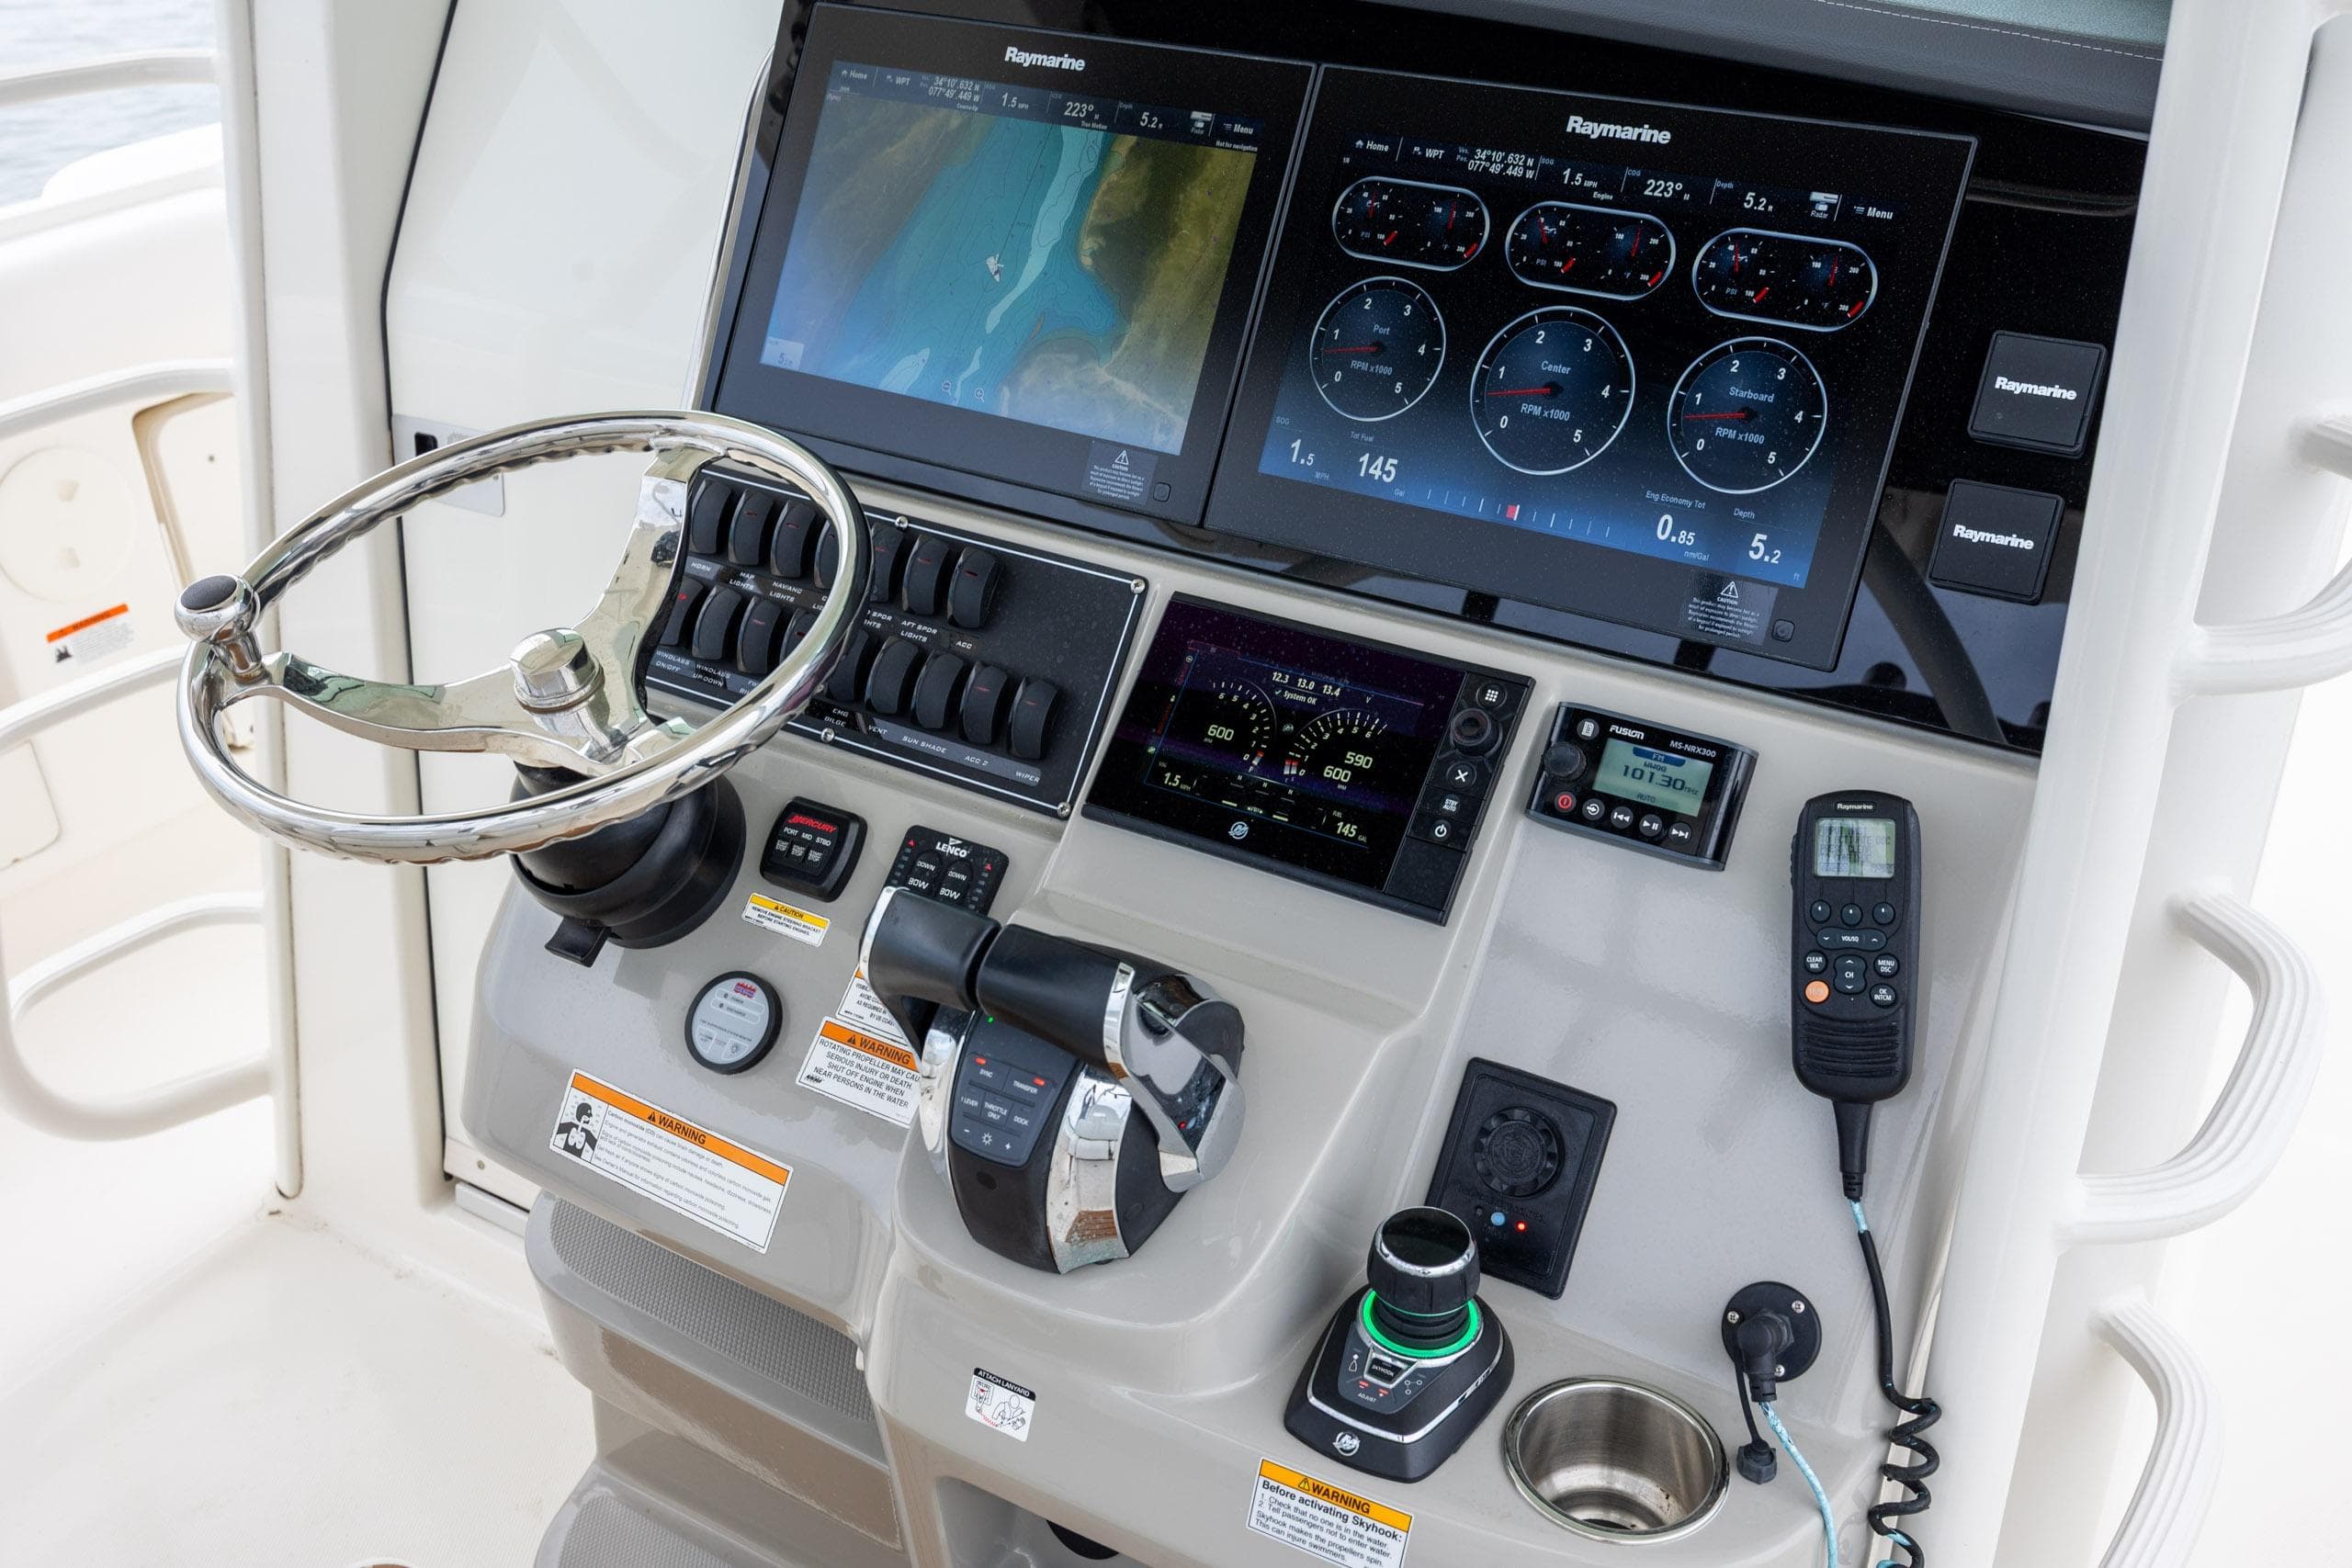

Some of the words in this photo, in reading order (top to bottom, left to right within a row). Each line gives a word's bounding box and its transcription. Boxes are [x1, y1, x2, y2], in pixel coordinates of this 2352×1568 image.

[1005, 46, 1085, 71] Raymarine
[850, 70, 867, 80] Home
[896, 75, 910, 86] WPT
[1001, 92, 1016, 108] 1.5
[1064, 102, 1094, 118] 223°
[1139, 112, 1159, 129] 5.2
[1233, 123, 1254, 135] Menu
[1566, 115, 1671, 144] Raymarine
[1366, 141, 1389, 152] Home
[1425, 148, 1444, 159] WPT
[1527, 157, 1533, 167] N
[1526, 170, 1534, 179] W
[1563, 167, 1583, 186] 1.5
[1584, 180, 1598, 188] MPH
[1627, 169, 1641, 177] COG
[1644, 179, 1683, 197] 223°
[1593, 191, 1613, 201] Engine
[1744, 192, 1767, 211] 5.2
[1810, 209, 1828, 220] Radar
[1867, 207, 1894, 220] Menu
[1725, 288, 1737, 296] PSI
[1364, 299, 1372, 310] 2
[1404, 305, 1411, 316] 3
[1333, 330, 1340, 340] 1
[1373, 324, 1390, 335] Port
[1535, 331, 1545, 344] 2
[1419, 344, 1426, 355] 4
[1351, 360, 1368, 371] RPM
[1369, 364, 1393, 376] x1000
[1541, 360, 1571, 376] Center
[1777, 367, 1786, 380] 3
[1334, 371, 1341, 382] 0
[1395, 382, 1402, 393] 5
[1728, 385, 1775, 403] Starboard
[1995, 376, 2076, 400] Raymarine
[1521, 402, 1542, 417] RPM
[1543, 408, 1570, 422] x1000
[1275, 416, 1290, 425] SOG
[1350, 431, 1360, 441] Tot
[1361, 434, 1374, 443] Fuel
[1714, 426, 1736, 441] RPM
[1737, 431, 1765, 445] x1000
[1290, 438, 1315, 466] 1.5
[1315, 471, 1329, 481] MPH
[1359, 453, 1397, 482] 145
[1394, 488, 1406, 497] Gal
[1645, 490, 1659, 502] Eng
[1660, 493, 1692, 509] Economy
[1694, 500, 1706, 509] Tot
[1734, 507, 1755, 520] Depth
[1656, 513, 1695, 546] 0.85
[1684, 549, 1710, 562] nm/Gal
[1953, 524, 2034, 550] Raymarine
[1748, 533, 1781, 564] 5.2
[1792, 572, 1800, 581] ft
[691, 562, 711, 572] HORN
[740, 571, 755, 580] MAP
[729, 579, 754, 591] LIGHTS
[770, 591, 795, 603] LIGHTS
[1717, 596, 1738, 605] CAUTION
[901, 620, 916, 628] AFT
[900, 630, 928, 642] LIGHTS
[956, 640, 972, 649] ACC
[656, 650, 690, 666] WINDLASS
[696, 663, 730, 679] WINDLASS
[1272, 671, 1289, 684] 12.3
[1297, 677, 1315, 690] 13.0
[1323, 684, 1340, 697] 13.4
[1283, 691, 1306, 704] System
[1306, 696, 1317, 705] OK
[832, 708, 849, 716] EMG
[867, 725, 888, 736] VENT
[1207, 725, 1234, 740] 600
[902, 736, 919, 746] SUN
[920, 739, 946, 754] SHADE
[1670, 739, 1716, 758] MS-NRX300
[965, 755, 981, 765] ACC
[1344, 751, 1374, 769] 590
[1016, 771, 1040, 783] WIPER
[1163, 772, 1181, 787] 1.5
[1323, 765, 1351, 782] 600
[1623, 764, 1685, 791] 101.30
[1637, 793, 1656, 803] AUTO
[788, 815, 837, 833] MERCURY
[1337, 821, 1358, 838] 145
[784, 827, 798, 837] PORT
[802, 832, 813, 840] MID
[816, 836, 831, 846] STBD
[935, 841, 967, 858] LENCO
[917, 861, 935, 871] DOWN
[908, 877, 929, 889] BOW
[948, 870, 967, 882] DOWN
[939, 887, 961, 900] BOW
[780, 905, 804, 919] CAUTION
[818, 1038, 851, 1056] ROTATING
[851, 1051, 890, 1071] PROPELLER
[890, 1066, 905, 1077] MAY
[857, 1036, 911, 1066] WARNING
[825, 1051, 855, 1067] SERIOUS
[854, 1062, 878, 1077] INJURY
[878, 1071, 889, 1081] OR
[979, 1068, 993, 1078] SYNC
[813, 1066, 832, 1078] NEAR
[831, 1073, 865, 1090] PERSONS
[864, 1086, 872, 1094] IN
[872, 1089, 886, 1099] THE
[826, 1061, 845, 1074] SHUT
[844, 1068, 859, 1078] OFF
[859, 1074, 884, 1089] ENGINE
[884, 1084, 905, 1097] WHEN
[1013, 1080, 1038, 1094] TRANSFER
[965, 1098, 978, 1107] LEVER
[985, 1102, 1008, 1116] THROTTLE
[988, 1111, 1001, 1121] ONLY
[1014, 1116, 1029, 1126] DOCK
[658, 1114, 707, 1145] WARNING
[1372, 1363, 1395, 1377] SKYHOOK
[978, 1371, 1001, 1384] ATTACH
[1001, 1381, 1030, 1396] LANYARD
[1358, 1392, 1376, 1404] ADJUST
[1311, 1482, 1370, 1515] WARNING
[1262, 1480, 1295, 1500] Before
[1298, 1494, 1348, 1524] activating
[1351, 1515, 1402, 1544] Skyhook:
[1268, 1495, 1294, 1512] Check
[1294, 1506, 1307, 1517] that
[1308, 1513, 1317, 1522] no
[1319, 1517, 1333, 1528] one
[1353, 1529, 1363, 1540] the
[1256, 1518, 1270, 1530] This
[1272, 1526, 1284, 1536] can
[1286, 1530, 1306, 1546] injure
[1268, 1504, 1280, 1514] Tell
[1282, 1510, 1323, 1533] passengers
[1326, 1527, 1338, 1537] not
[1348, 1536, 1366, 1549] enter
[1256, 1509, 1286, 1529] Skyhook
[1289, 1523, 1313, 1539] makes
[1315, 1533, 1326, 1544] the
[1328, 1539, 1363, 1561] propellers
